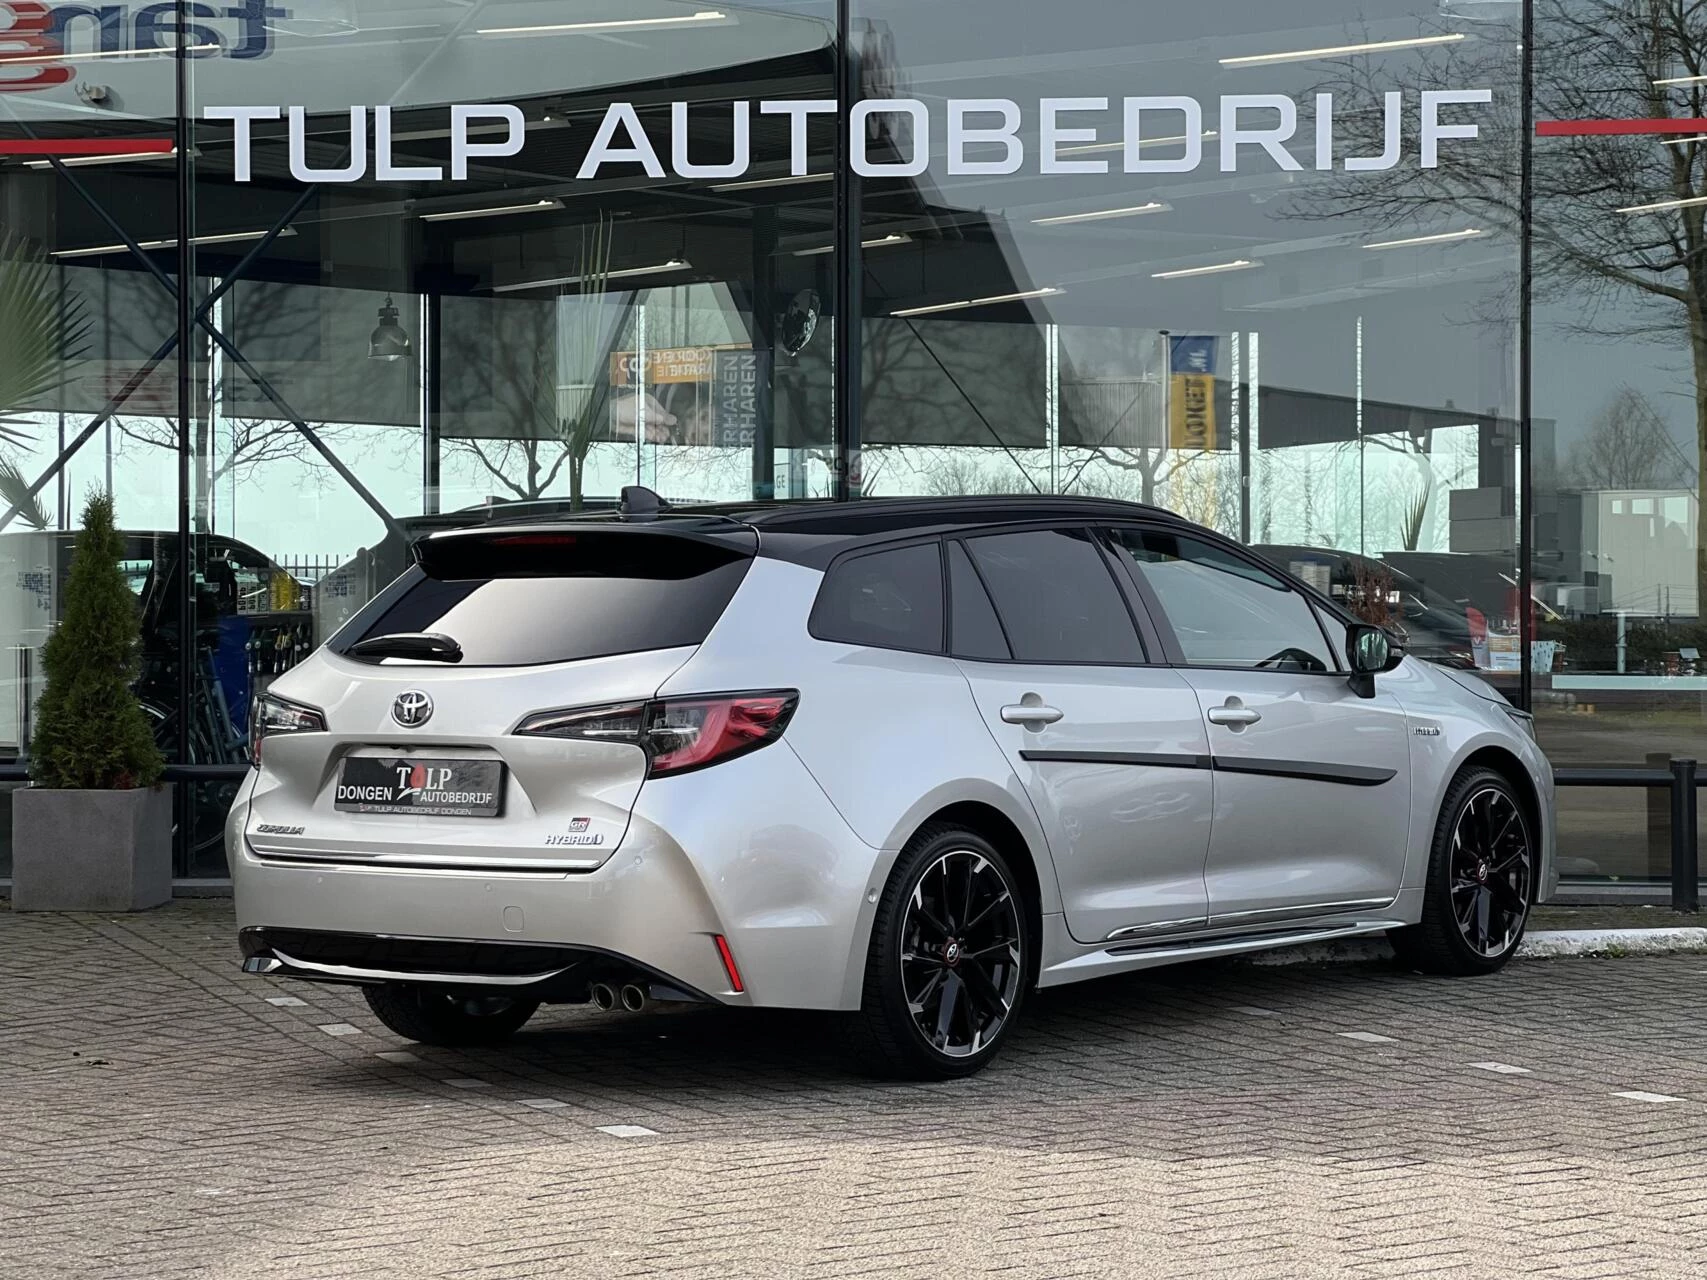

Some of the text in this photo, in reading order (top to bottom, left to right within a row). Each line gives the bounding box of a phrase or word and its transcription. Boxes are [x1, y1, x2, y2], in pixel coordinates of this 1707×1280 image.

[203, 89, 1492, 183] TULP AUTOBEDRIJF
[337, 785, 393, 801] DONGEN
[420, 792, 493, 804] AUTOBEDRIJF
[374, 805, 472, 816] TULP AUTOBEDRIJF DONGEN
[545, 834, 594, 845] HYBRID
